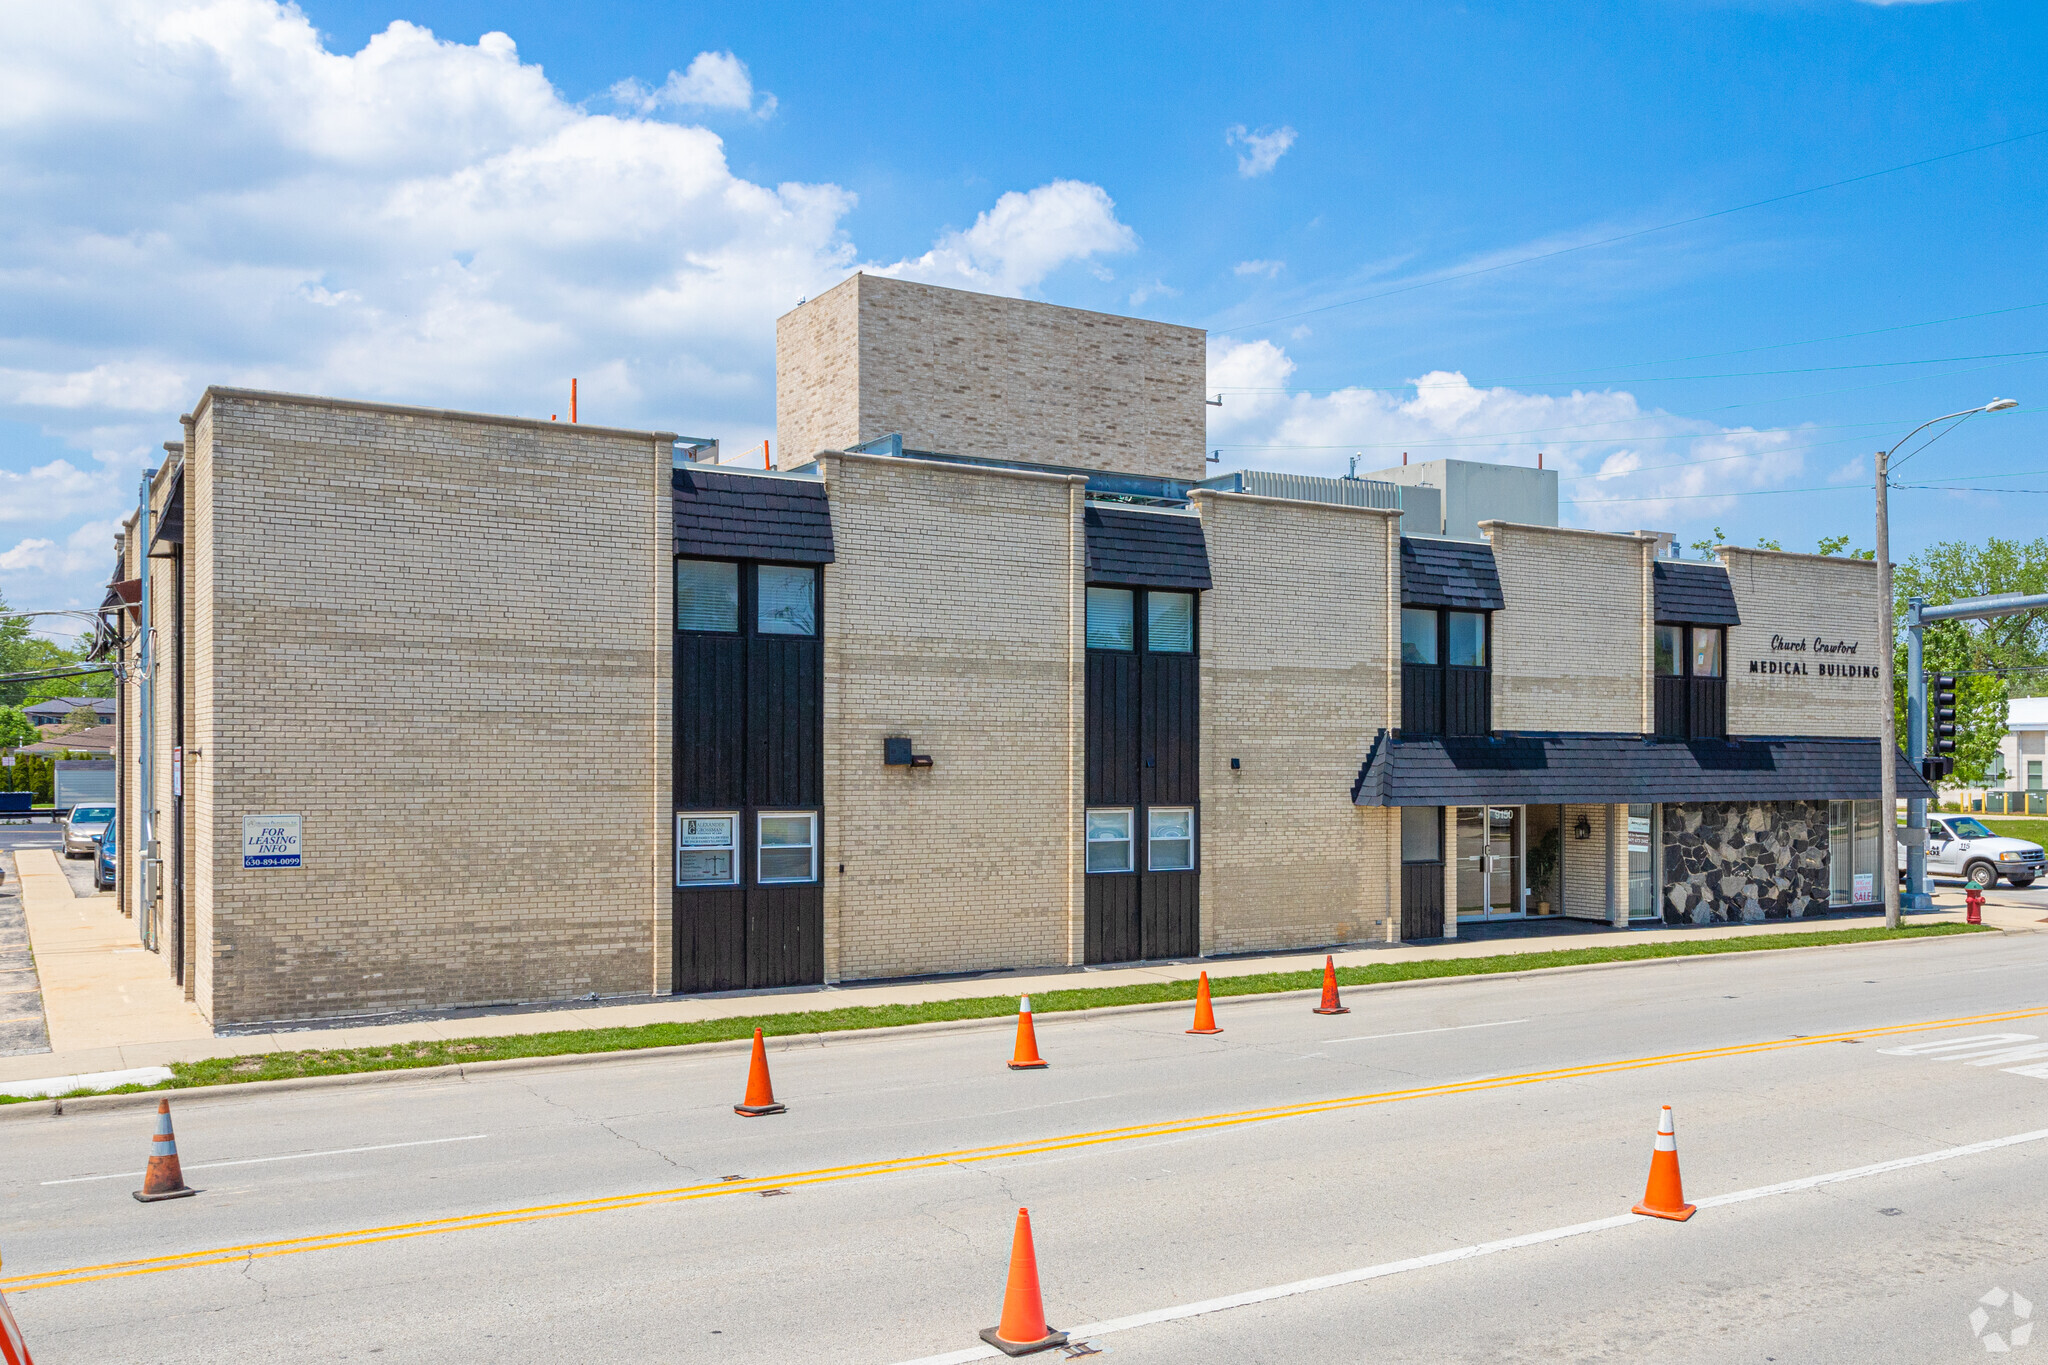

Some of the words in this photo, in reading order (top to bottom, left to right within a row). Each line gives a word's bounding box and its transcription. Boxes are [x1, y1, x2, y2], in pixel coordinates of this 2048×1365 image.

[1771, 634, 1806, 651] Church
[1813, 637, 1858, 654] Crawford
[1749, 660, 1808, 675] MEDICAL
[1819, 663, 1879, 678] BUILDING
[1494, 810, 1514, 819] 9150
[261, 828, 284, 836] FOR
[248, 836, 297, 844] LEASING
[259, 845, 287, 853] INFO
[246, 858, 299, 866] 630-894-0099
[1854, 892, 1871, 902] SALE
